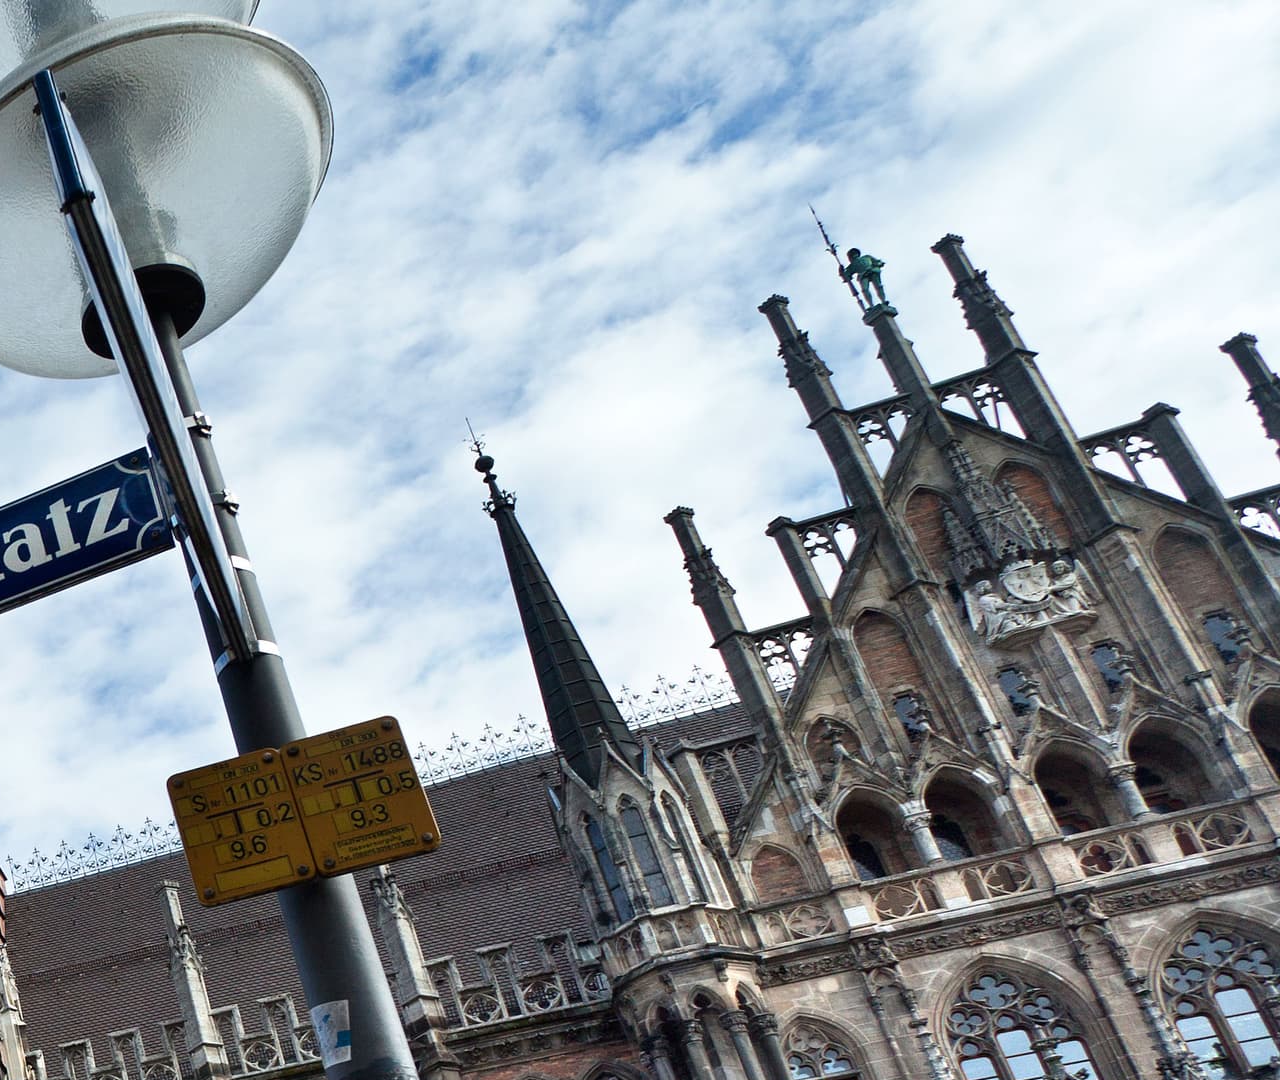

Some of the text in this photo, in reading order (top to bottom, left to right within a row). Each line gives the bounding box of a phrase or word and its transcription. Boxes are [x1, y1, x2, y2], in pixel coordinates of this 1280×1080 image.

[292, 763, 323, 785] KS
[344, 742, 404, 771] 1488
[192, 794, 207, 813] S
[226, 774, 282, 803] 1101
